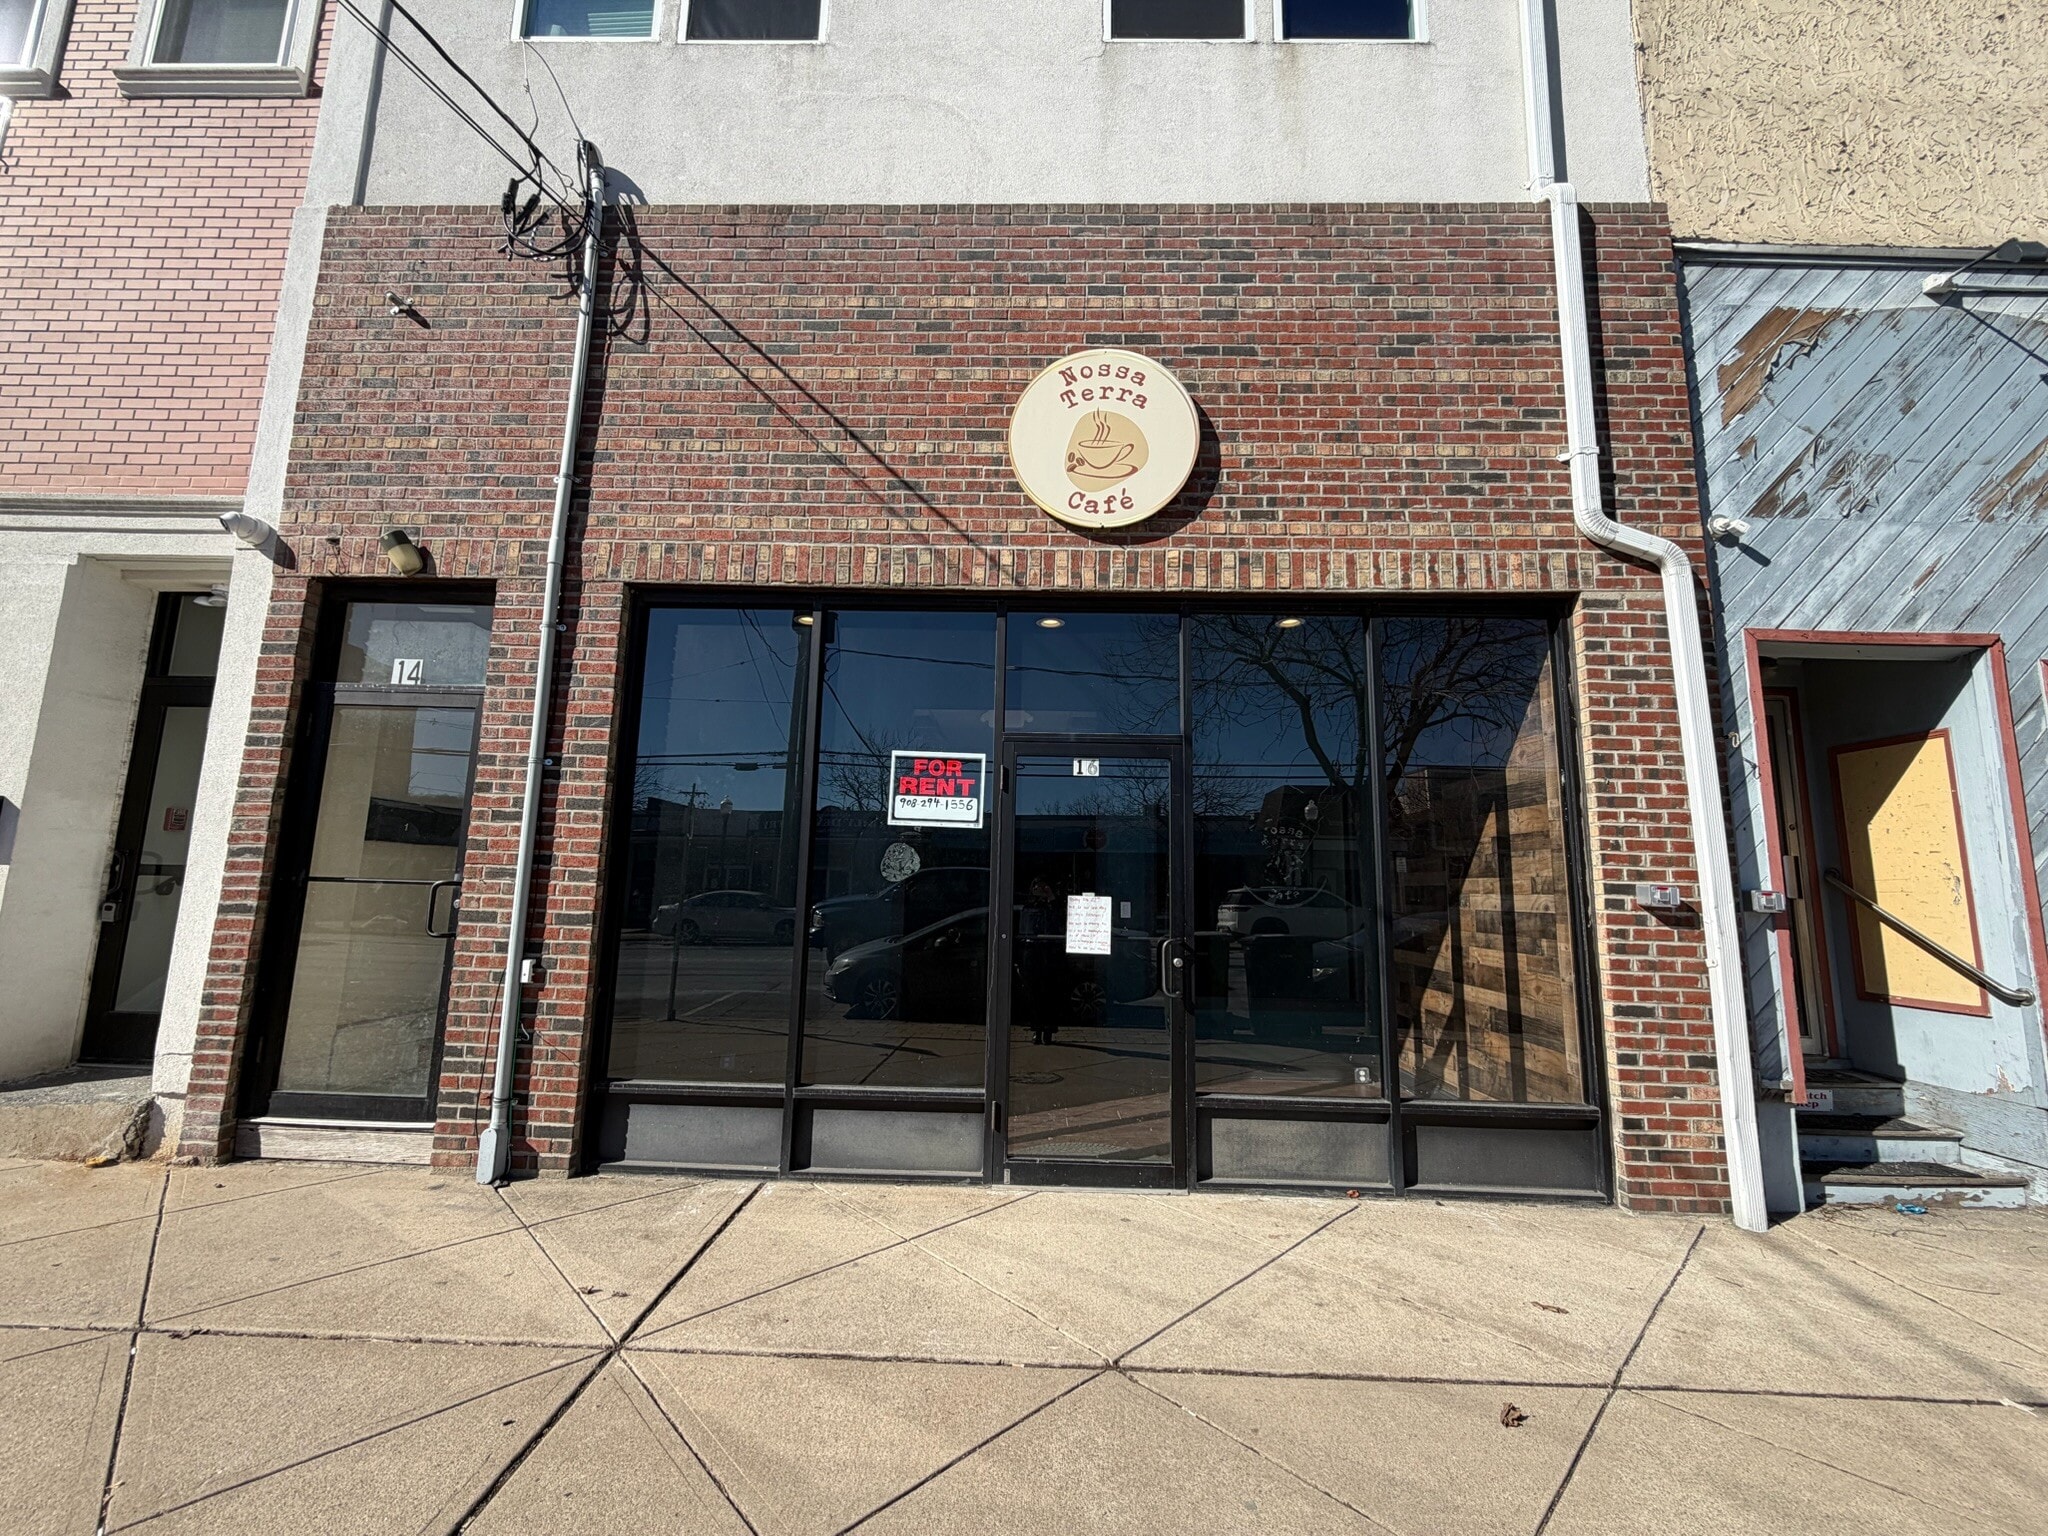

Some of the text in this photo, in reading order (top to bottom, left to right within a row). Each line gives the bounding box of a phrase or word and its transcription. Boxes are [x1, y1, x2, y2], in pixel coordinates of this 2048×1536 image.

[1058, 363, 1147, 387] Nossa
[1059, 385, 1148, 410] Terra
[1067, 487, 1135, 514] Café
[398, 660, 421, 685] 14
[913, 758, 963, 777] FOR
[1076, 759, 1098, 776] 16
[898, 776, 976, 797] RENT
[899, 797, 974, 811] 908-294-1556
